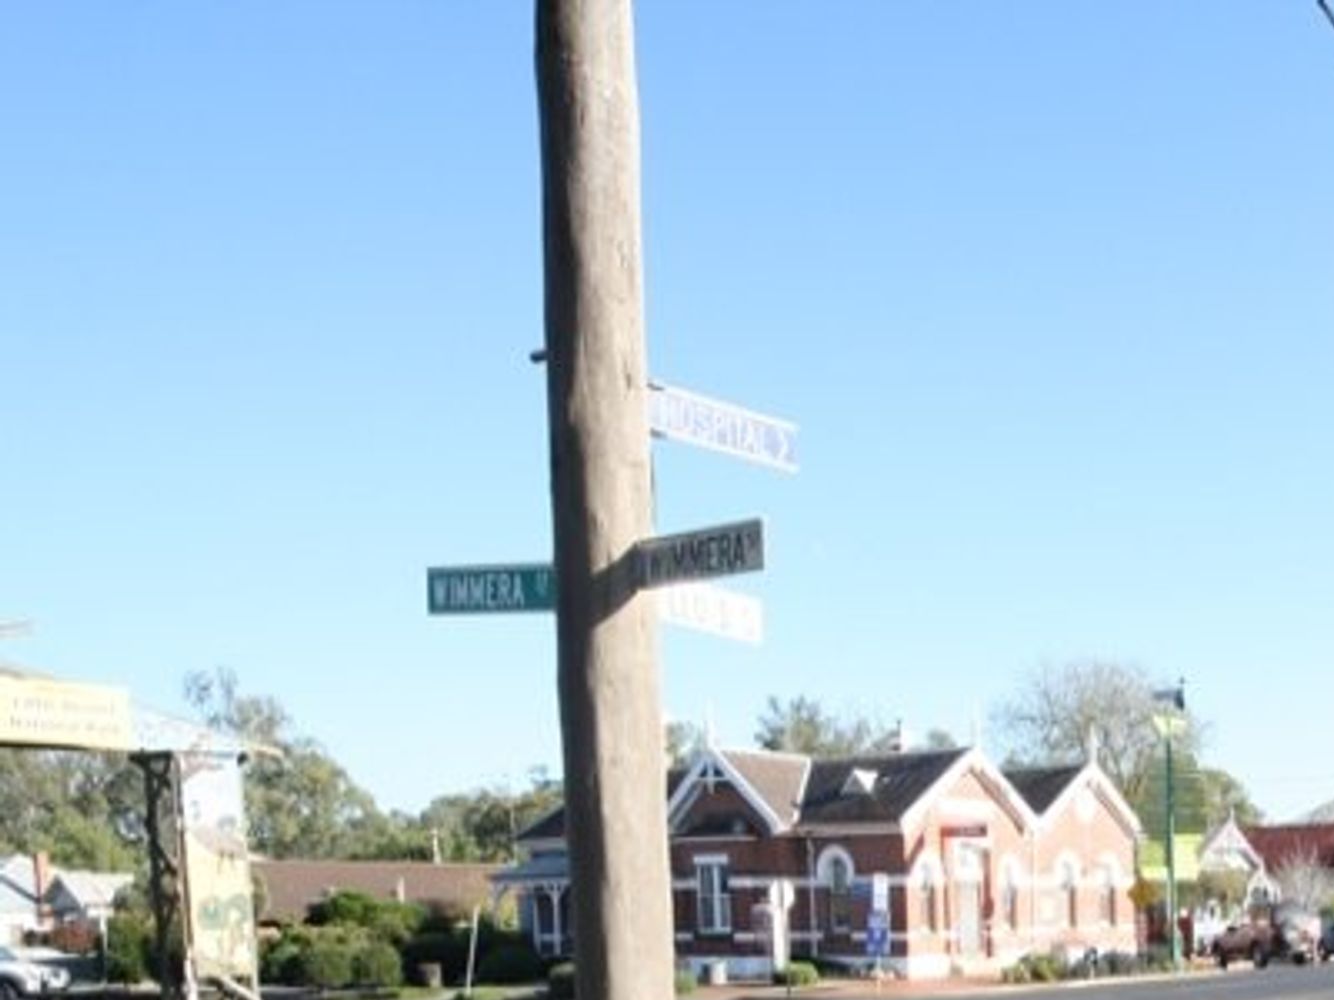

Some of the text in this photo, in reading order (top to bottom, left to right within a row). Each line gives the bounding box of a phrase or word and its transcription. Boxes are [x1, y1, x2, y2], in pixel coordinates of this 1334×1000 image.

[659, 395, 771, 458] HOSPITAL
[649, 533, 745, 582] WIMMERA
[433, 572, 524, 608] WIMMERA
